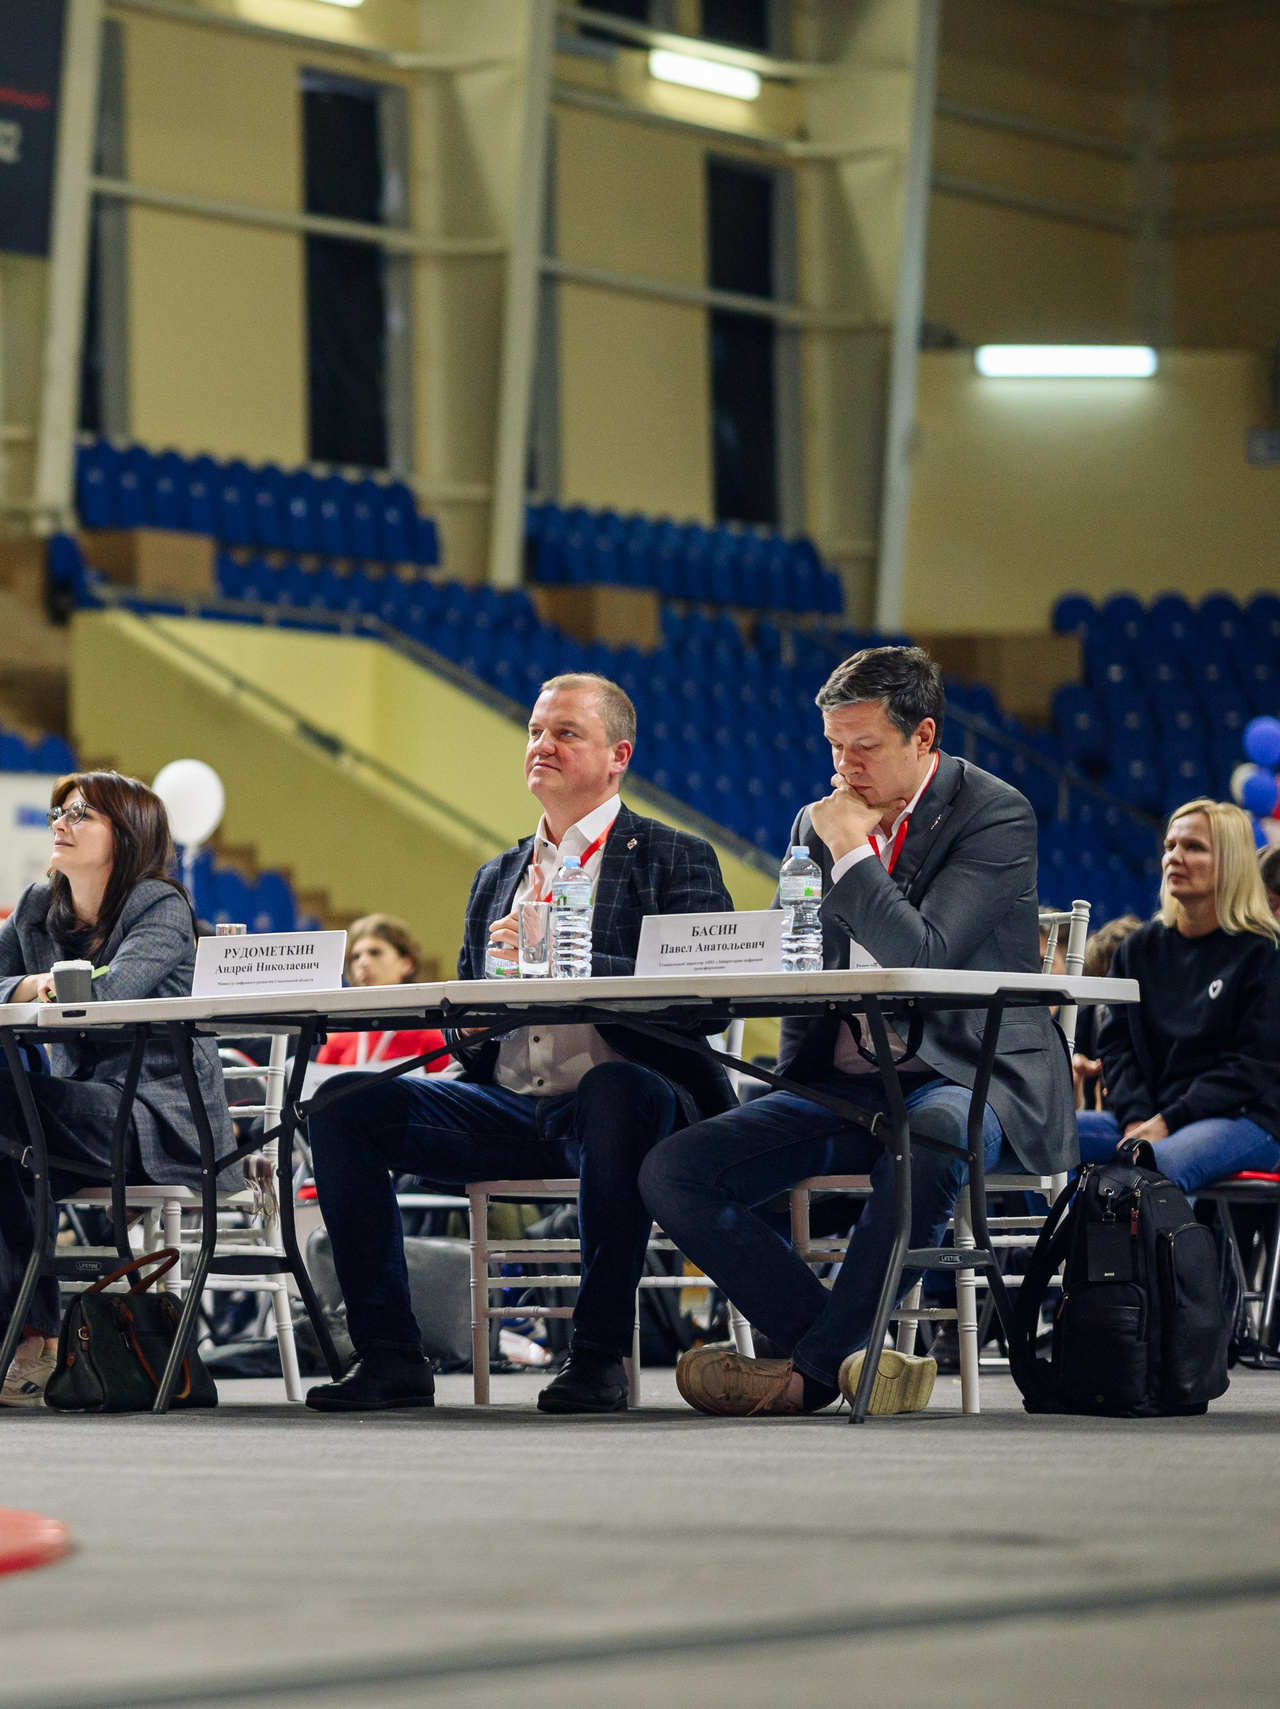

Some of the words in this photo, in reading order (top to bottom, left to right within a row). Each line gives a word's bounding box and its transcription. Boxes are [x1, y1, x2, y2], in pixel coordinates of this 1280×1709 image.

[691, 923, 738, 937] БАСИН
[224, 944, 315, 959] РУДОМЕТКИН
[660, 944, 693, 954] Павел
[695, 940, 765, 953] Анатольевич
[215, 963, 253, 975] Андрей
[256, 961, 319, 972] Николаевич
